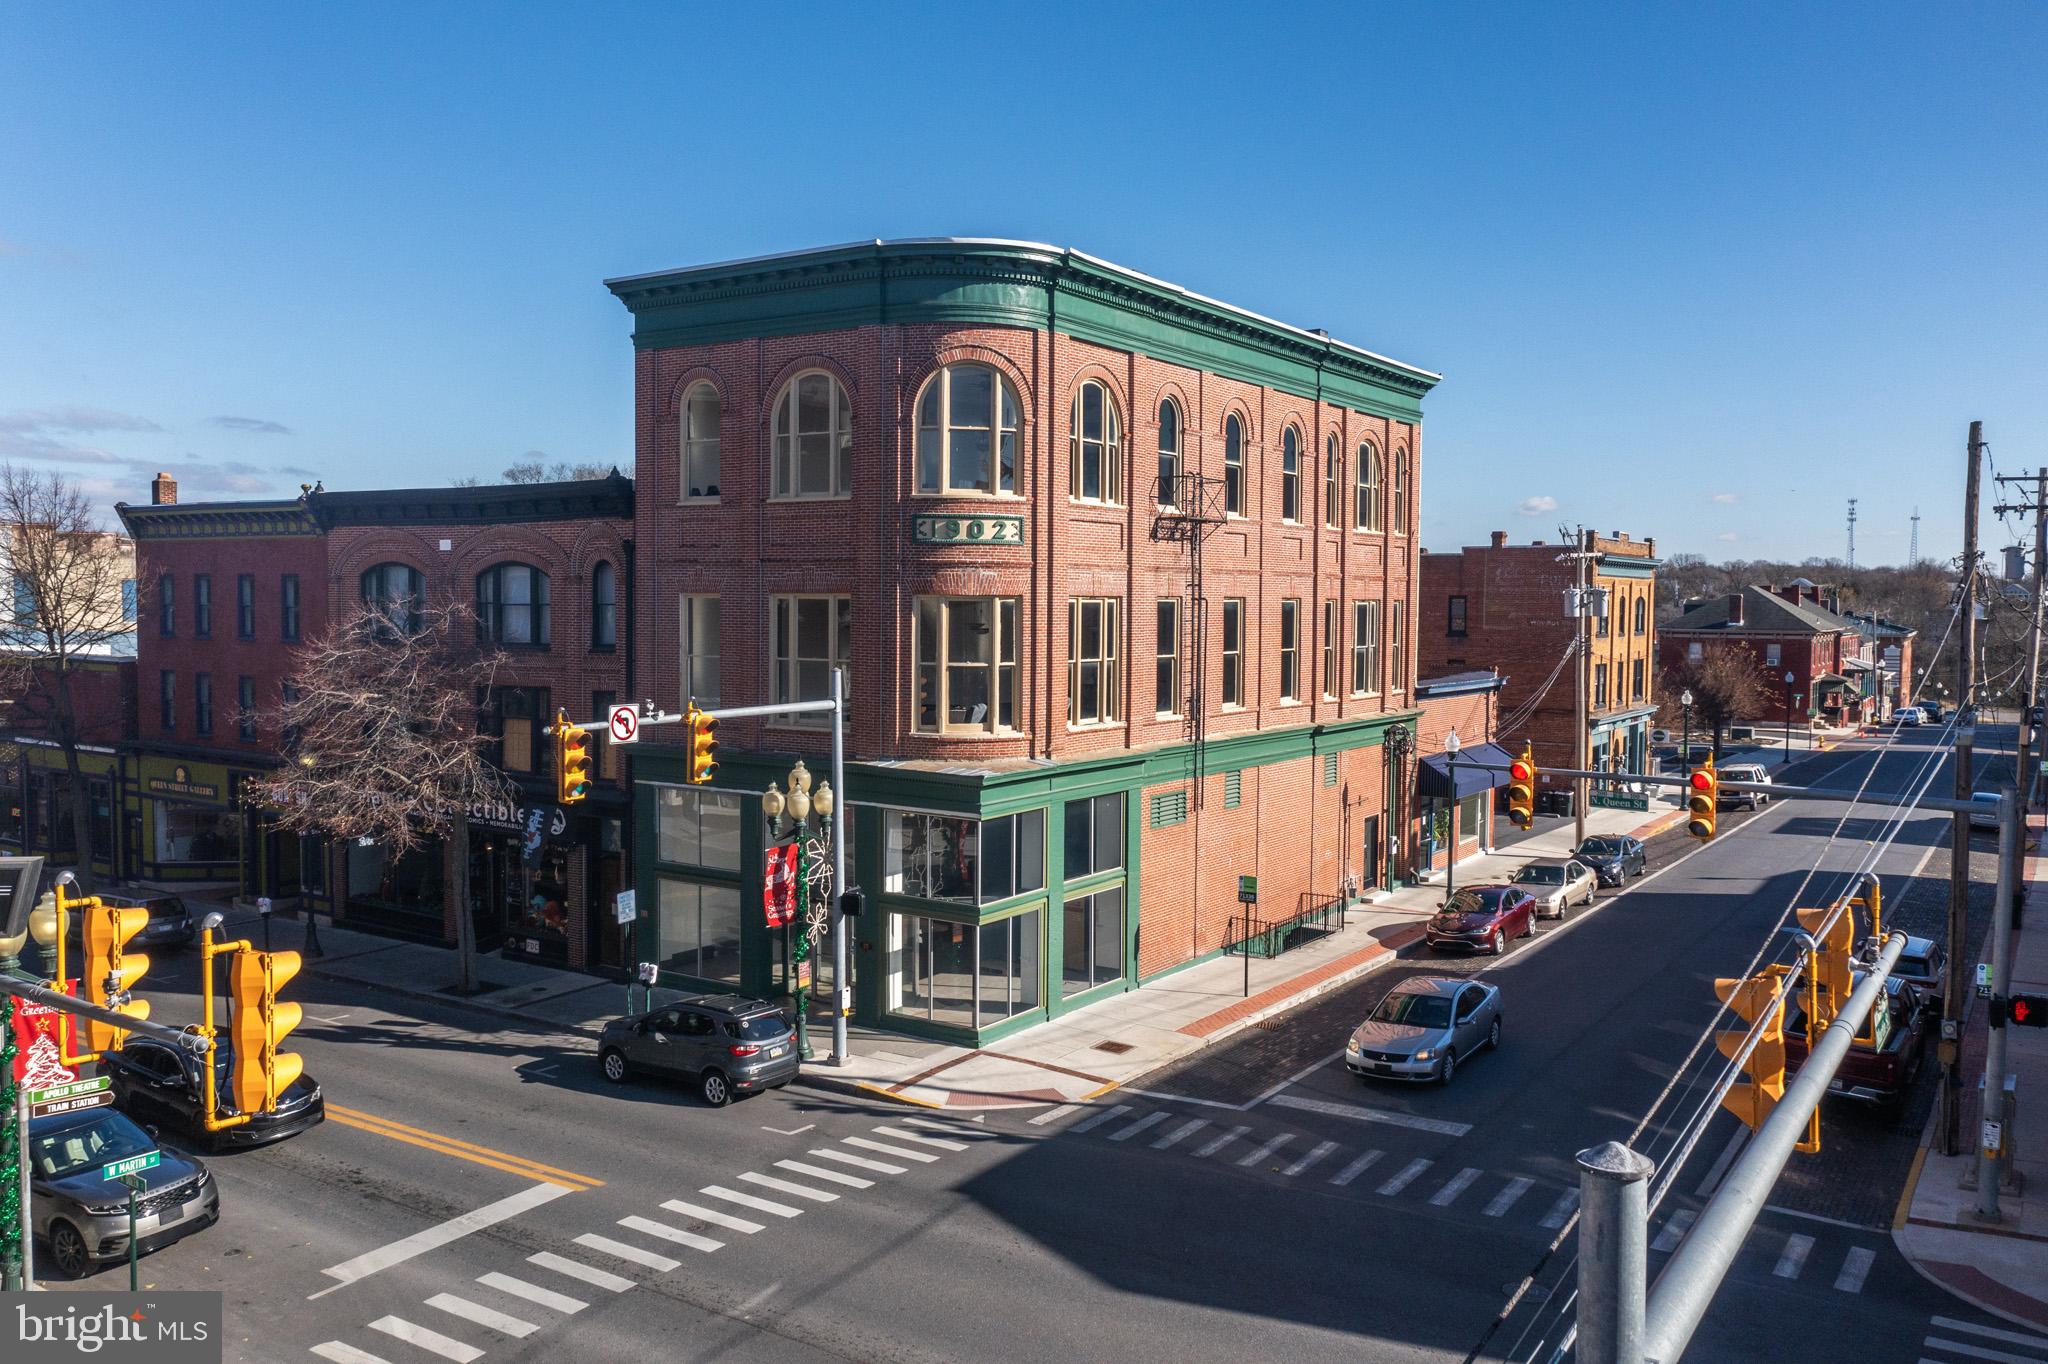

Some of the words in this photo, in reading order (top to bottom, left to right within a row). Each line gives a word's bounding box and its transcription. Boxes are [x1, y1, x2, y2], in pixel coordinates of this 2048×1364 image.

[931, 519, 1007, 541] 1902
[1602, 797, 1631, 808] Queen
[1633, 800, 1646, 809] St.
[43, 1086, 70, 1100] APOLLO
[71, 1080, 100, 1092] THEATRE
[47, 1102, 70, 1114] TRAIN
[71, 1096, 100, 1108] STATION
[108, 1166, 116, 1177] W
[119, 1157, 147, 1172] MARTIN
